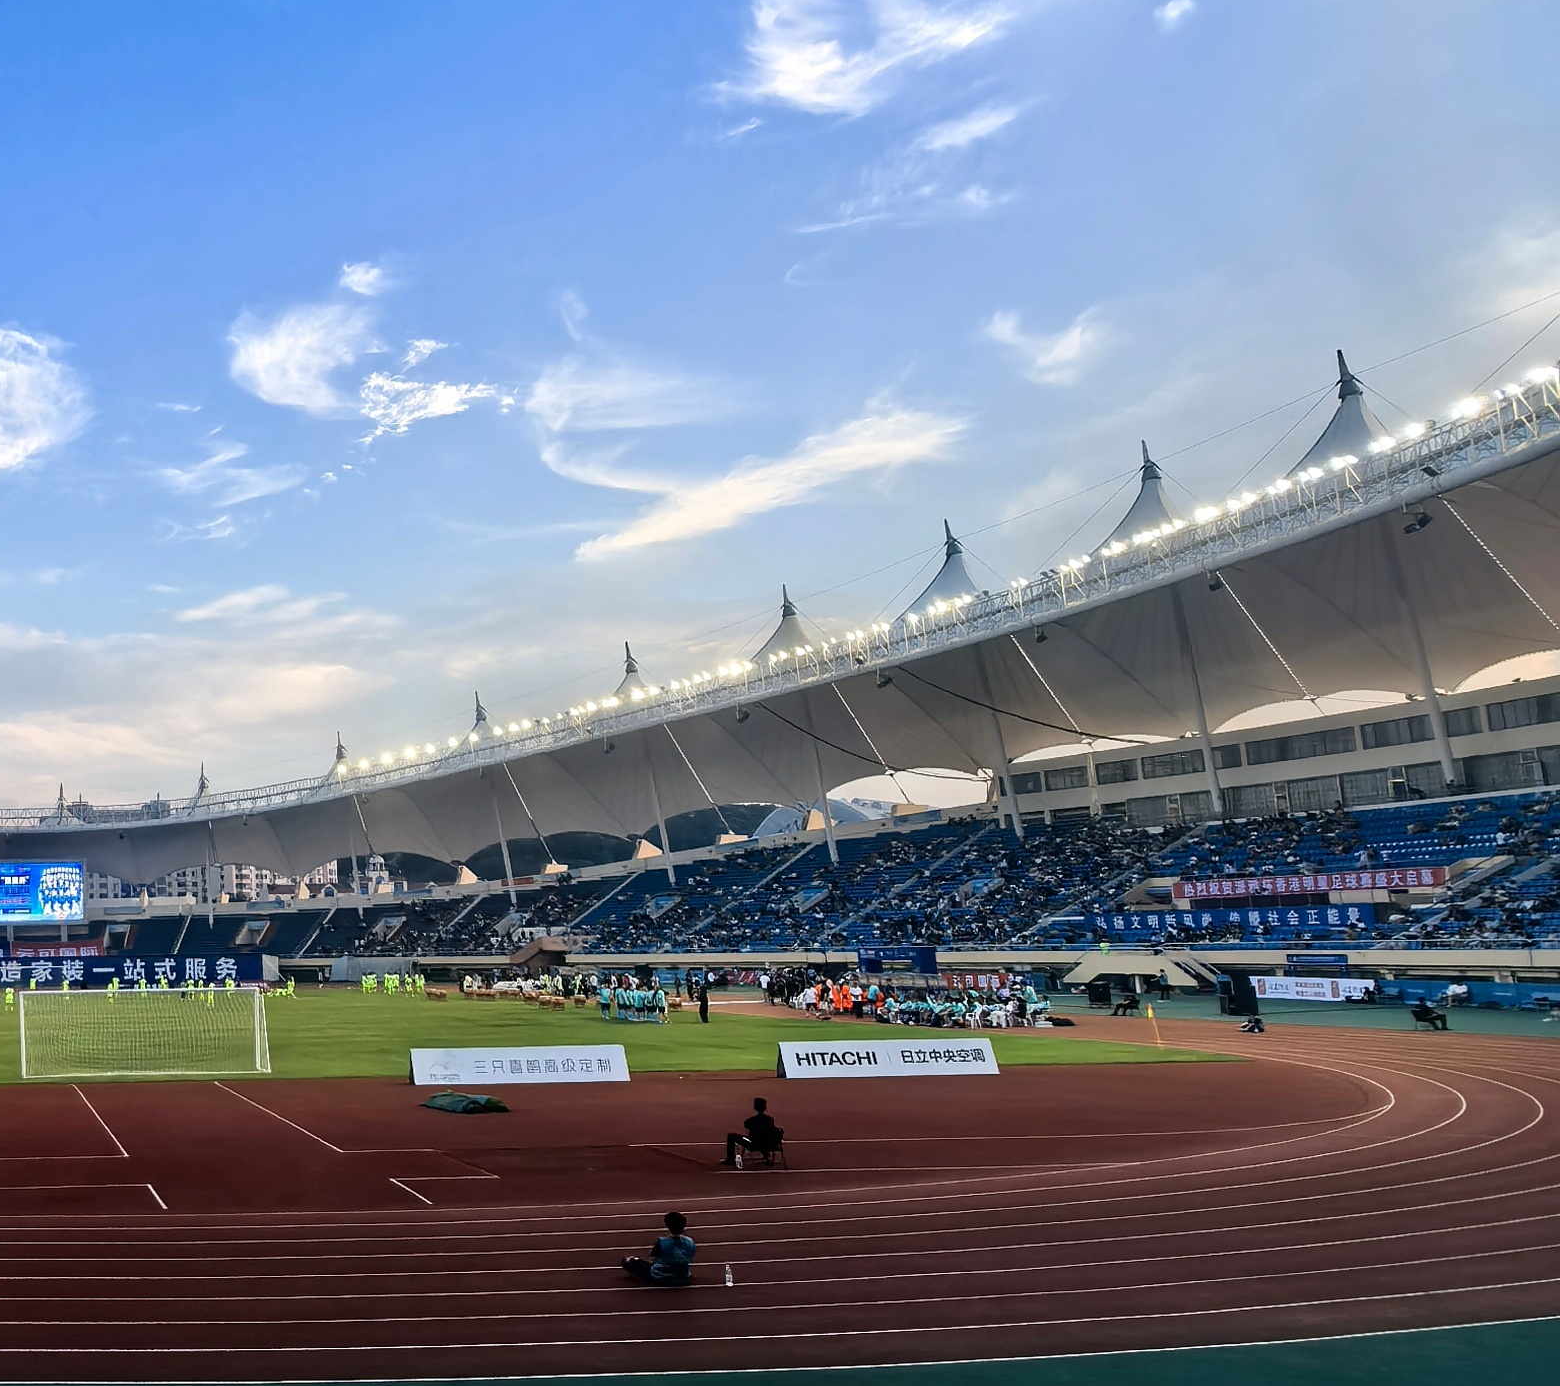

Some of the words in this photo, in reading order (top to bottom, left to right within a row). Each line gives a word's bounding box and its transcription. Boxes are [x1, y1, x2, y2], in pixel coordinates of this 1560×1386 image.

[43, 900, 81, 915] ASSA
[795, 1051, 878, 1066] HITACHI
[901, 1048, 986, 1063] 日立中央空调
